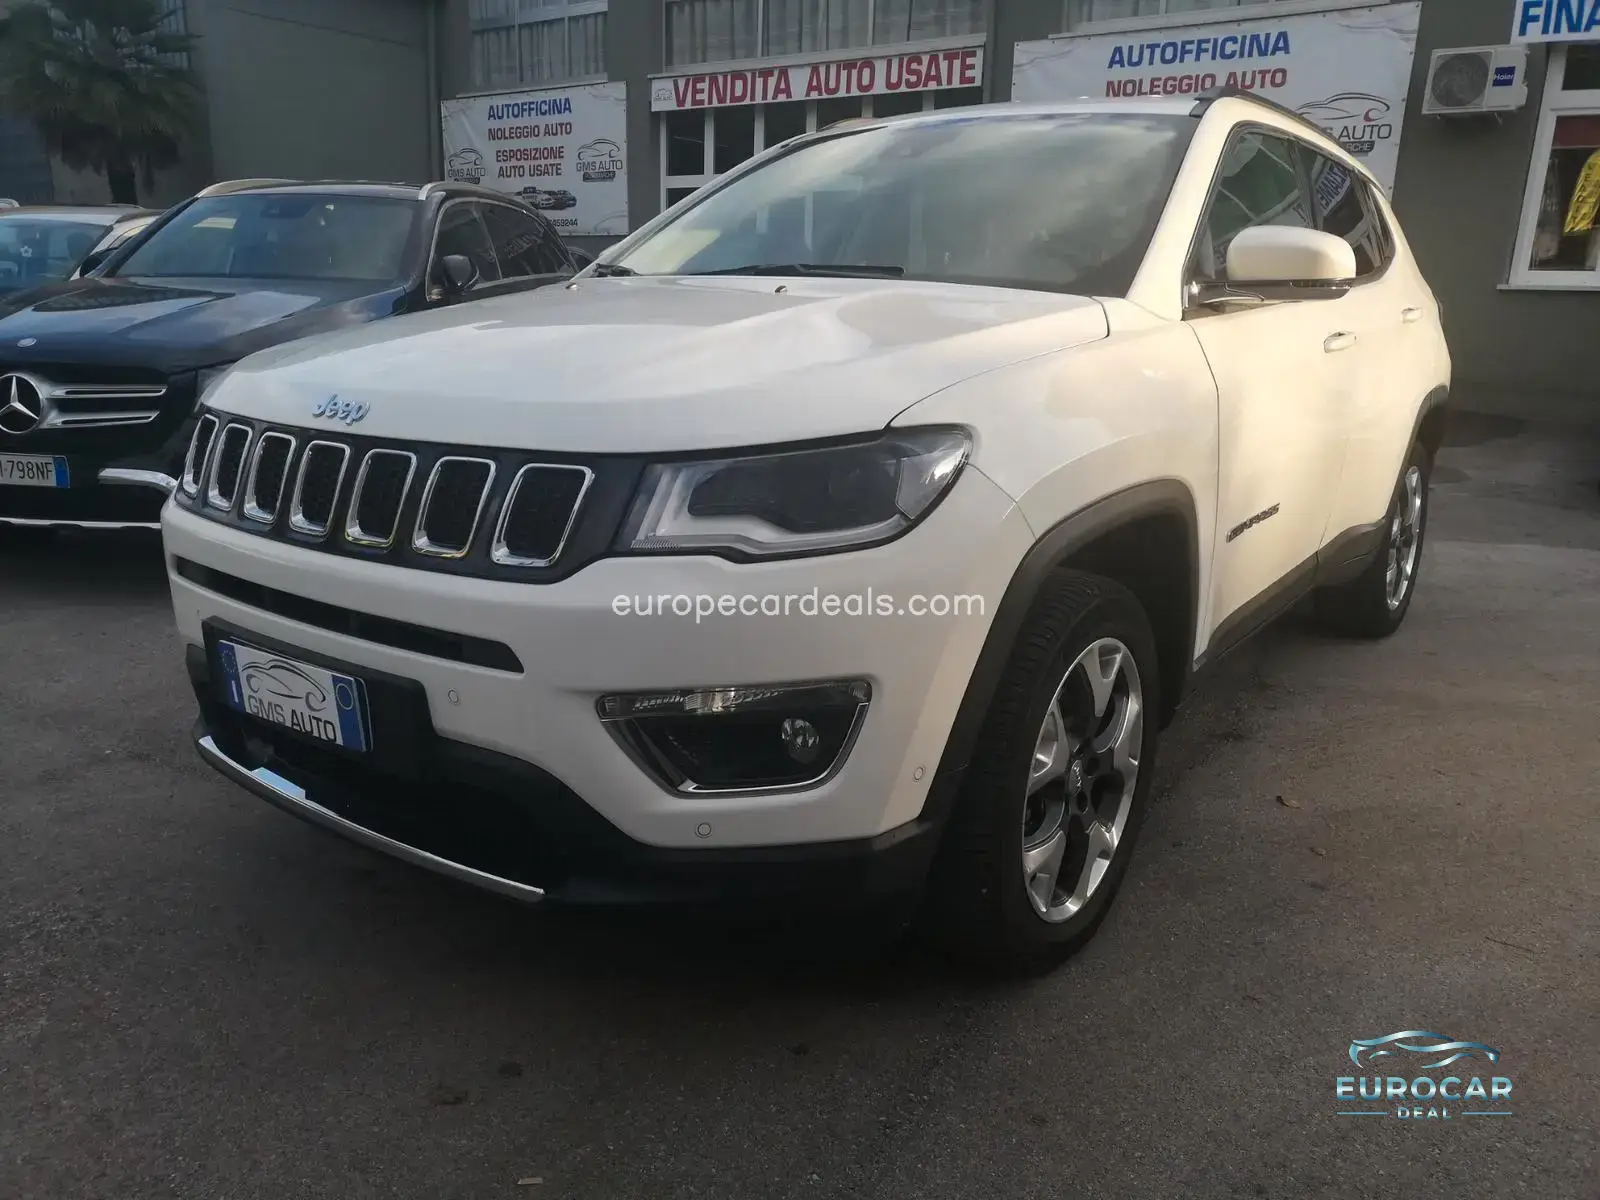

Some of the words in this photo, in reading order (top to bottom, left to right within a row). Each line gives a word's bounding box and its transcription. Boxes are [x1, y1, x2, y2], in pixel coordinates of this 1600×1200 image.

[1107, 30, 1291, 69] AUTOFFICINA
[673, 67, 792, 108] VENDITA
[805, 60, 875, 98] AUTO
[885, 50, 977, 90] USATE
[1105, 74, 1216, 98] NOLEGGIO
[1224, 67, 1287, 91] AUTO
[488, 97, 572, 121] AUTOFFICINA
[543, 122, 573, 136] AUTO
[1338, 124, 1392, 140] AUTO
[495, 146, 565, 163] ESPOSIZIONE
[576, 161, 597, 171] GMS
[598, 159, 623, 171] AUTO
[497, 164, 525, 178] AUTO
[529, 163, 562, 177] USATE
[312, 394, 371, 426] Jeep
[247, 695, 286, 725] GMS
[290, 708, 337, 743] AUTO
